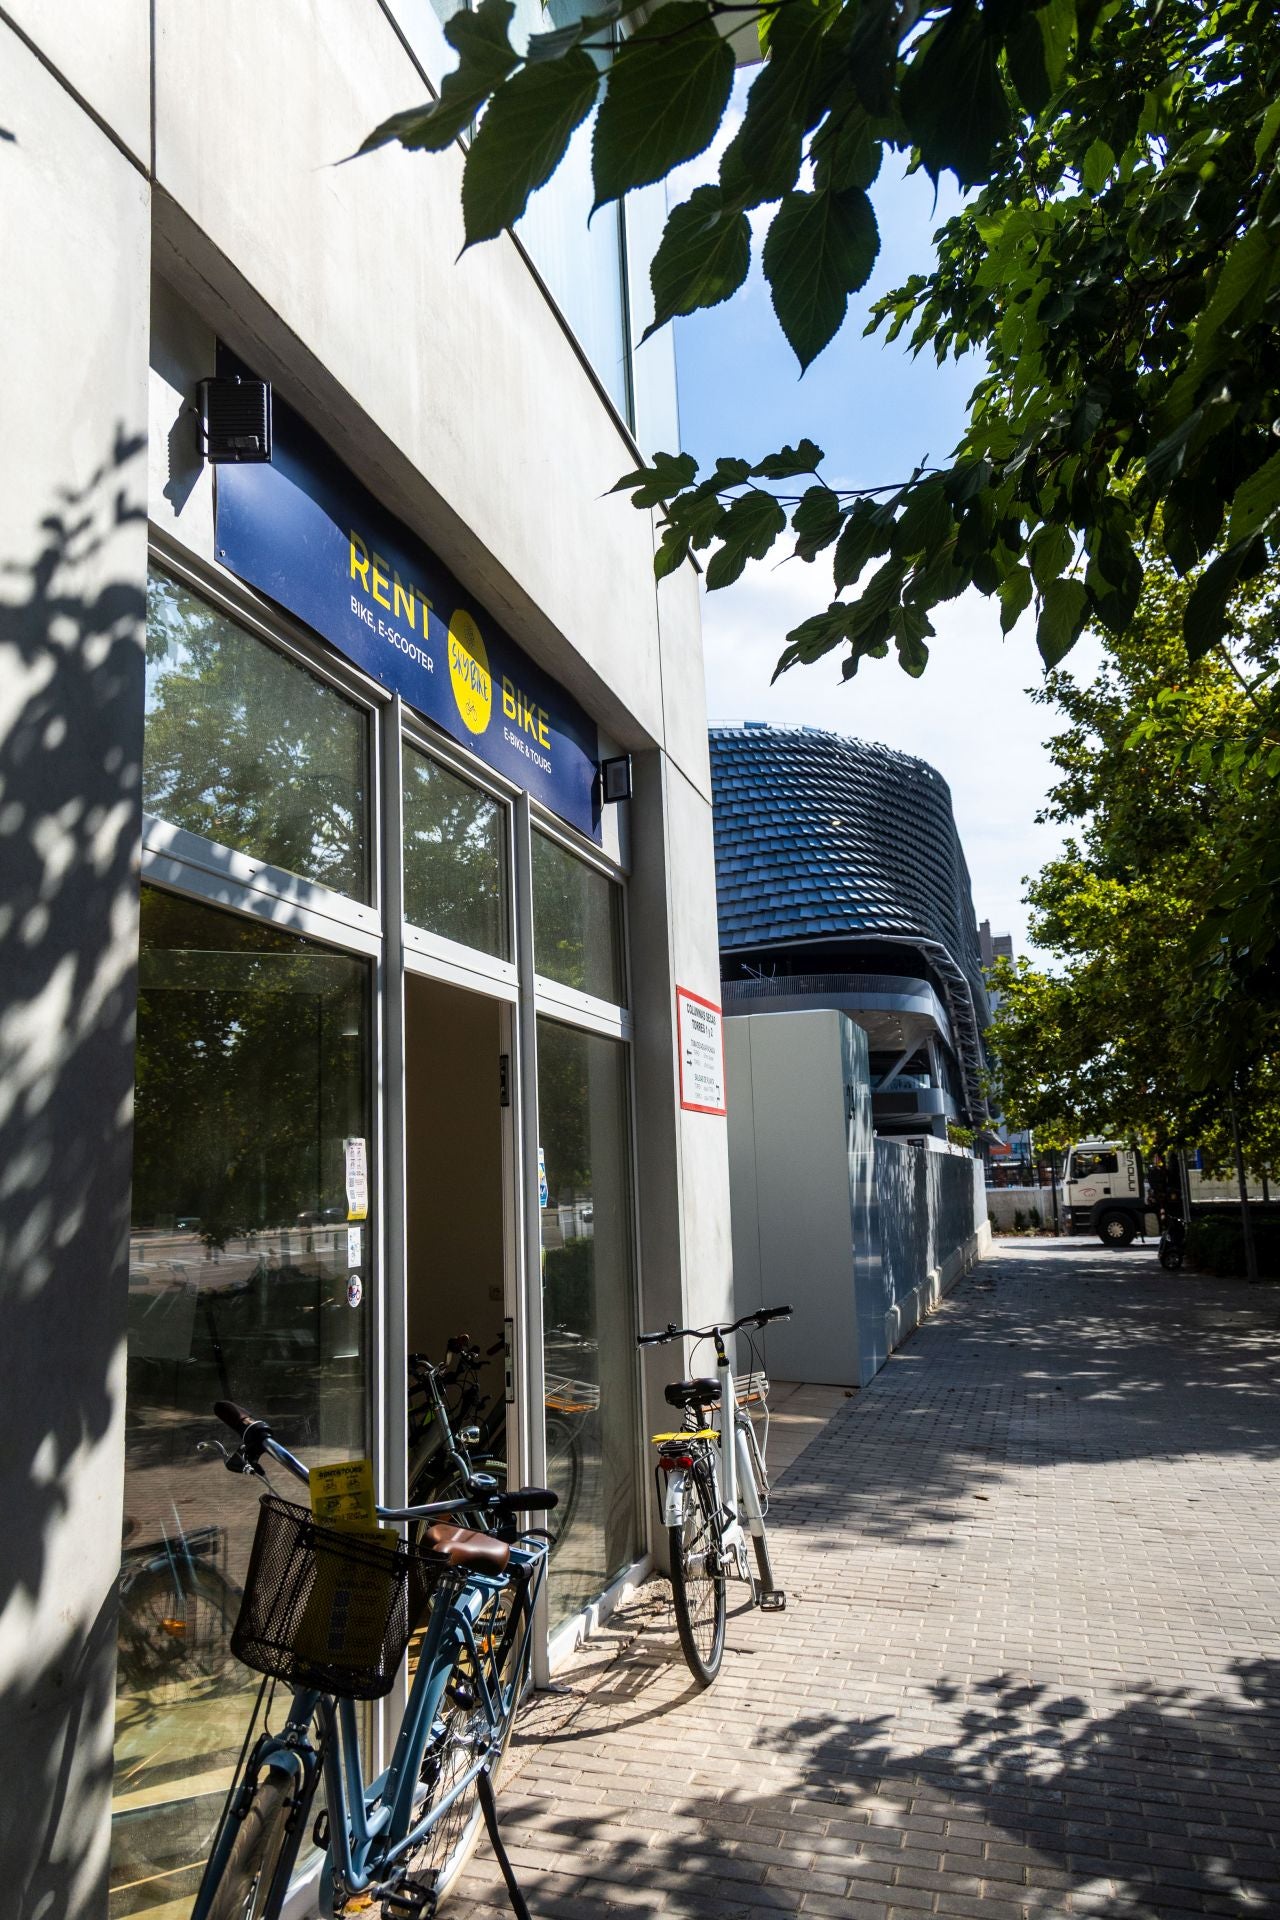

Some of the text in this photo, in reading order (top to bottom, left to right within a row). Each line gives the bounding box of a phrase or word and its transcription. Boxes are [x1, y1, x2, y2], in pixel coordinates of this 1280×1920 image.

[350, 529, 434, 641] RENT
[350, 595, 434, 674] BIKE, E-SCOOTER
[502, 674, 551, 750] BIKE
[503, 726, 525, 757] E-BIKE
[530, 750, 552, 774] TOURS
